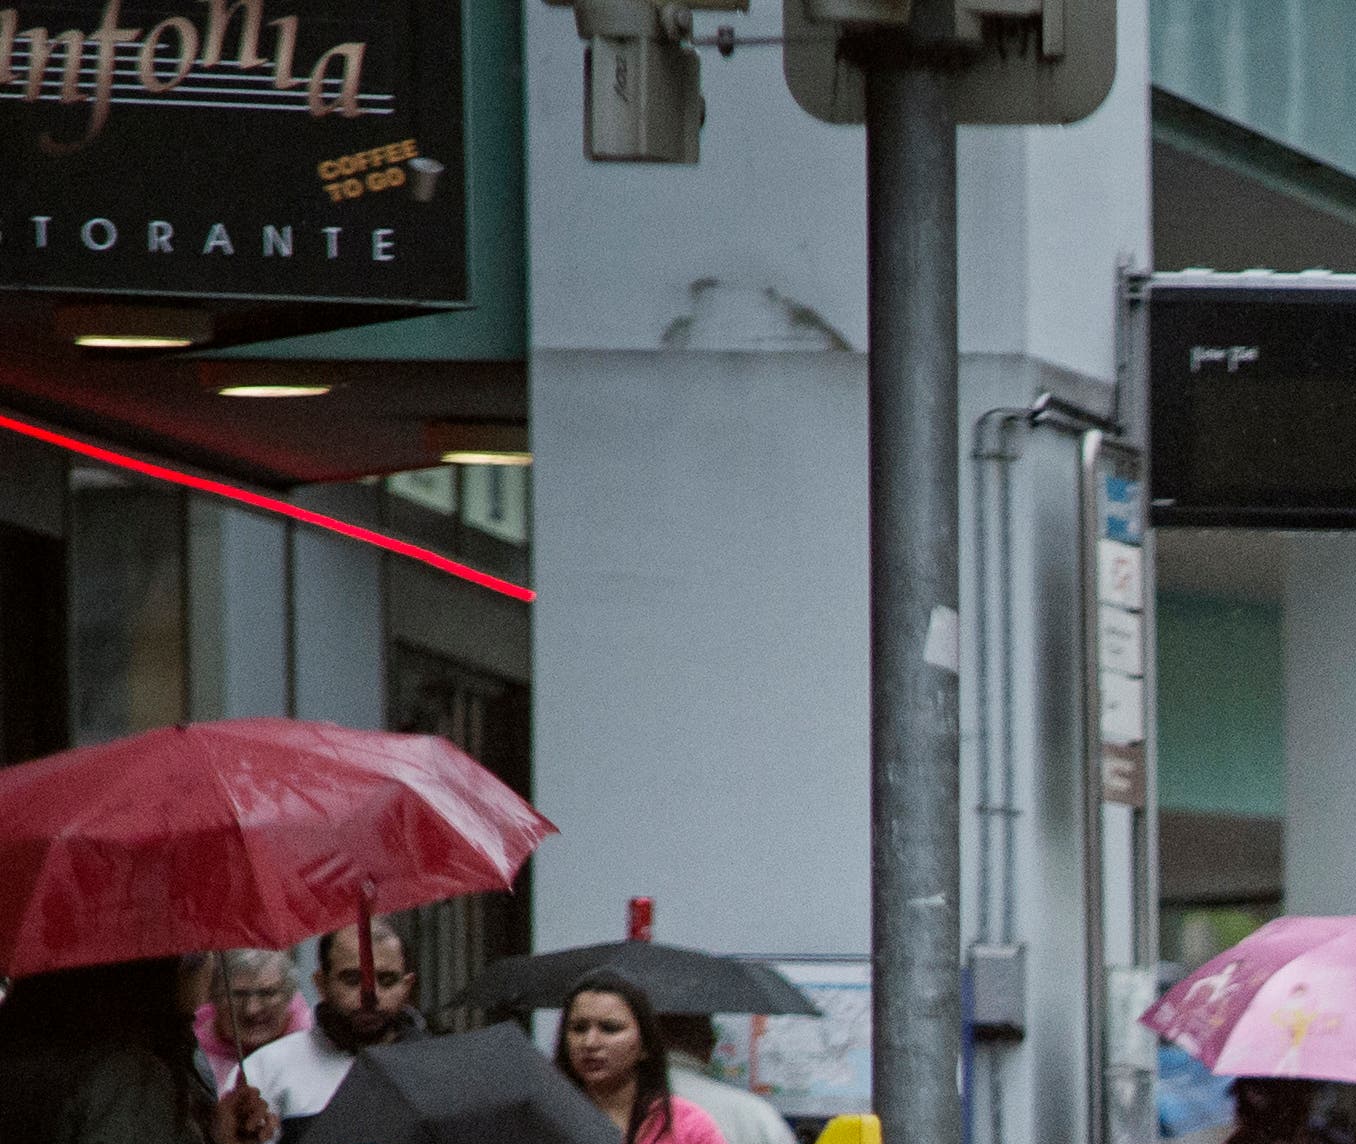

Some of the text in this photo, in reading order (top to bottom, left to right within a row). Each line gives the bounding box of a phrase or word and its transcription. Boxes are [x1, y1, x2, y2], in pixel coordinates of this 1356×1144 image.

[319, 138, 419, 180] COFFEE
[323, 166, 406, 202] TO GO
[0, 216, 396, 262] TORANTE
